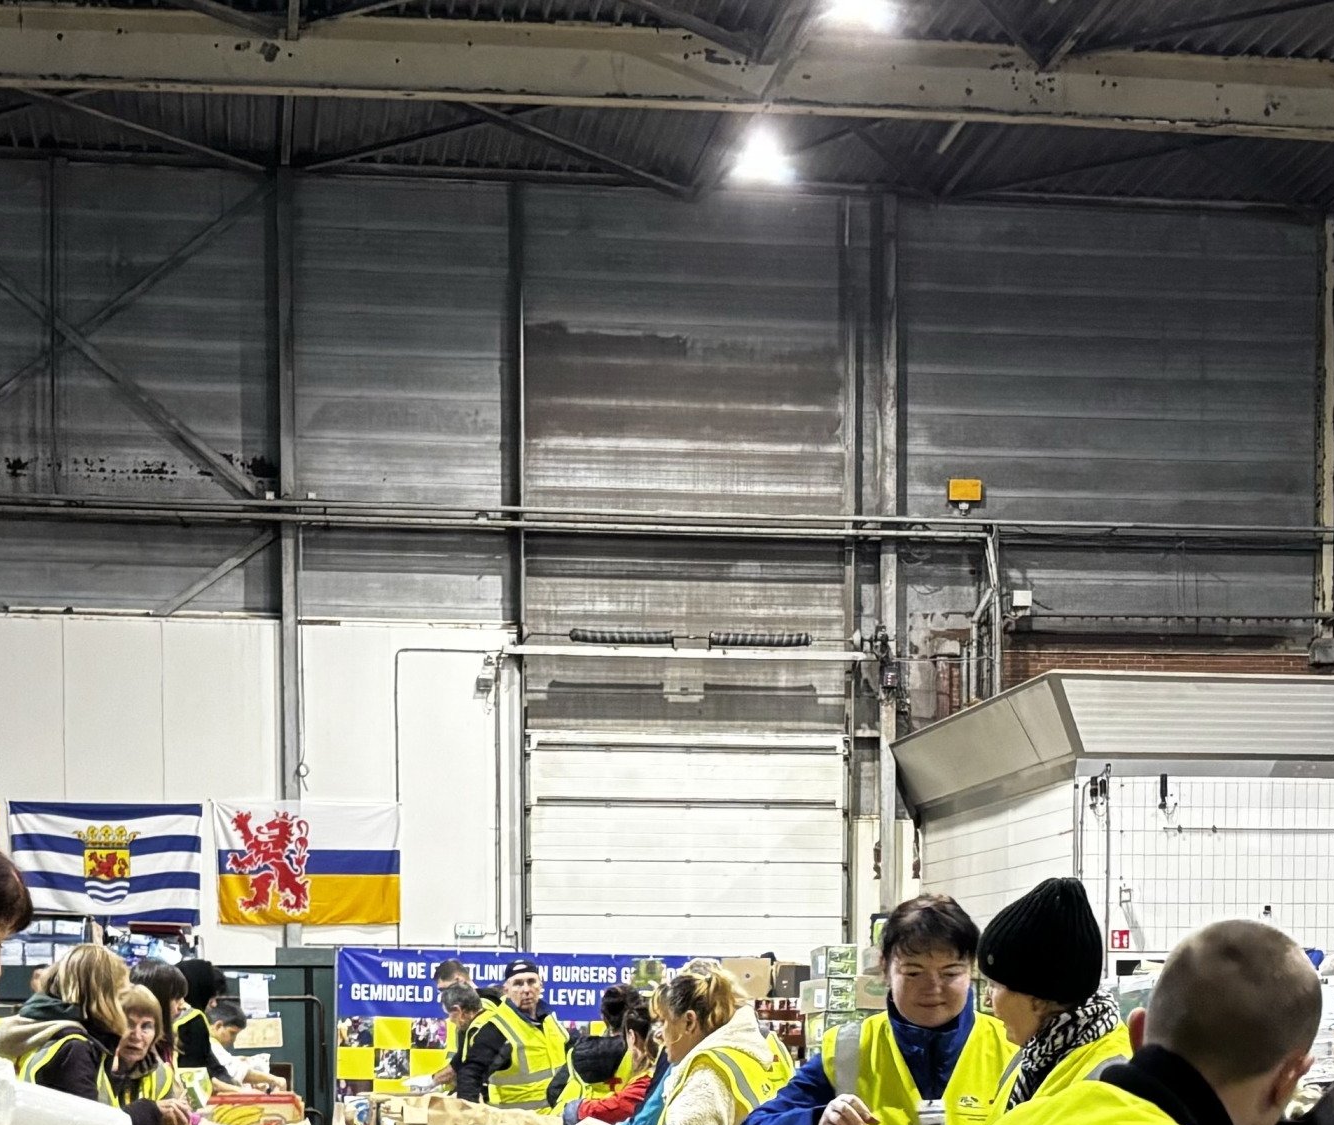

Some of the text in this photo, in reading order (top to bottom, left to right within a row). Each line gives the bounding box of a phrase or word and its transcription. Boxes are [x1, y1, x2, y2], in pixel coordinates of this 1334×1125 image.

[407, 962, 427, 980] DE
[552, 965, 618, 984] BURGERS
[350, 982, 434, 1003] GEMIDDELD
[548, 988, 596, 1007] LEVEN
